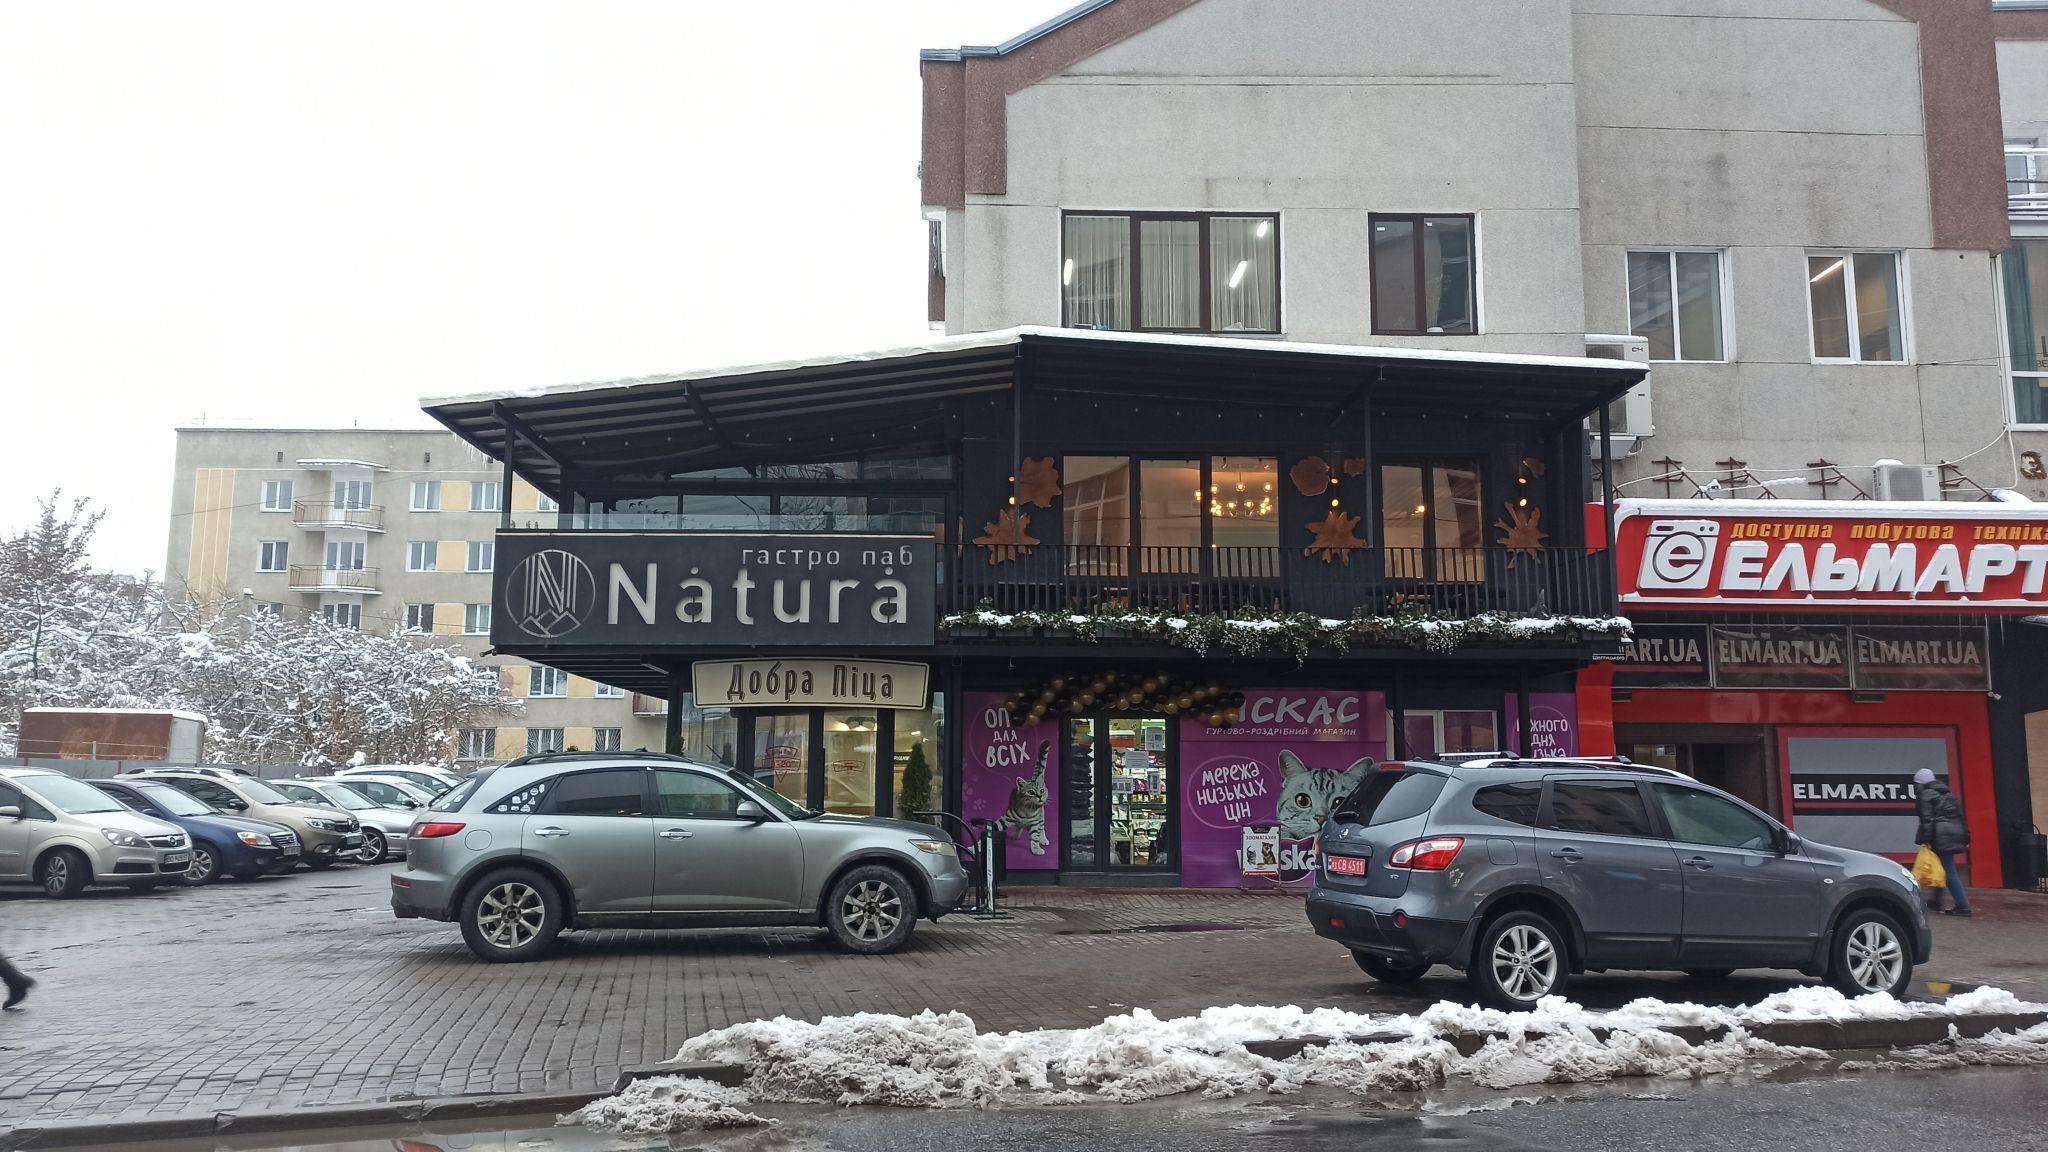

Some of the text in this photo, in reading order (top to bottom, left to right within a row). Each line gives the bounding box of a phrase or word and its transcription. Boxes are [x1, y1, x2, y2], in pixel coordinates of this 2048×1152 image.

[1730, 523, 1833, 541] доступна
[1850, 522, 1955, 542] побутова
[742, 545, 913, 571] гастро паб
[1719, 540, 2048, 595] ЕЛЬМАРТ
[1624, 638, 1702, 662] ART.UA
[1718, 639, 1842, 665] ELMART.UA
[1857, 640, 1980, 664] ELMART.UA
[727, 661, 893, 704] Добра Піца
[985, 707, 1010, 728] ОП
[1238, 696, 1360, 724] ІСКАС
[1312, 728, 1357, 736] МАГАЗИН
[1515, 718, 1568, 733] ЖНОГО
[1531, 733, 1555, 747] ДНЯ
[986, 740, 1030, 768] ВСІХ
[1792, 783, 1917, 800] ELMART.U
